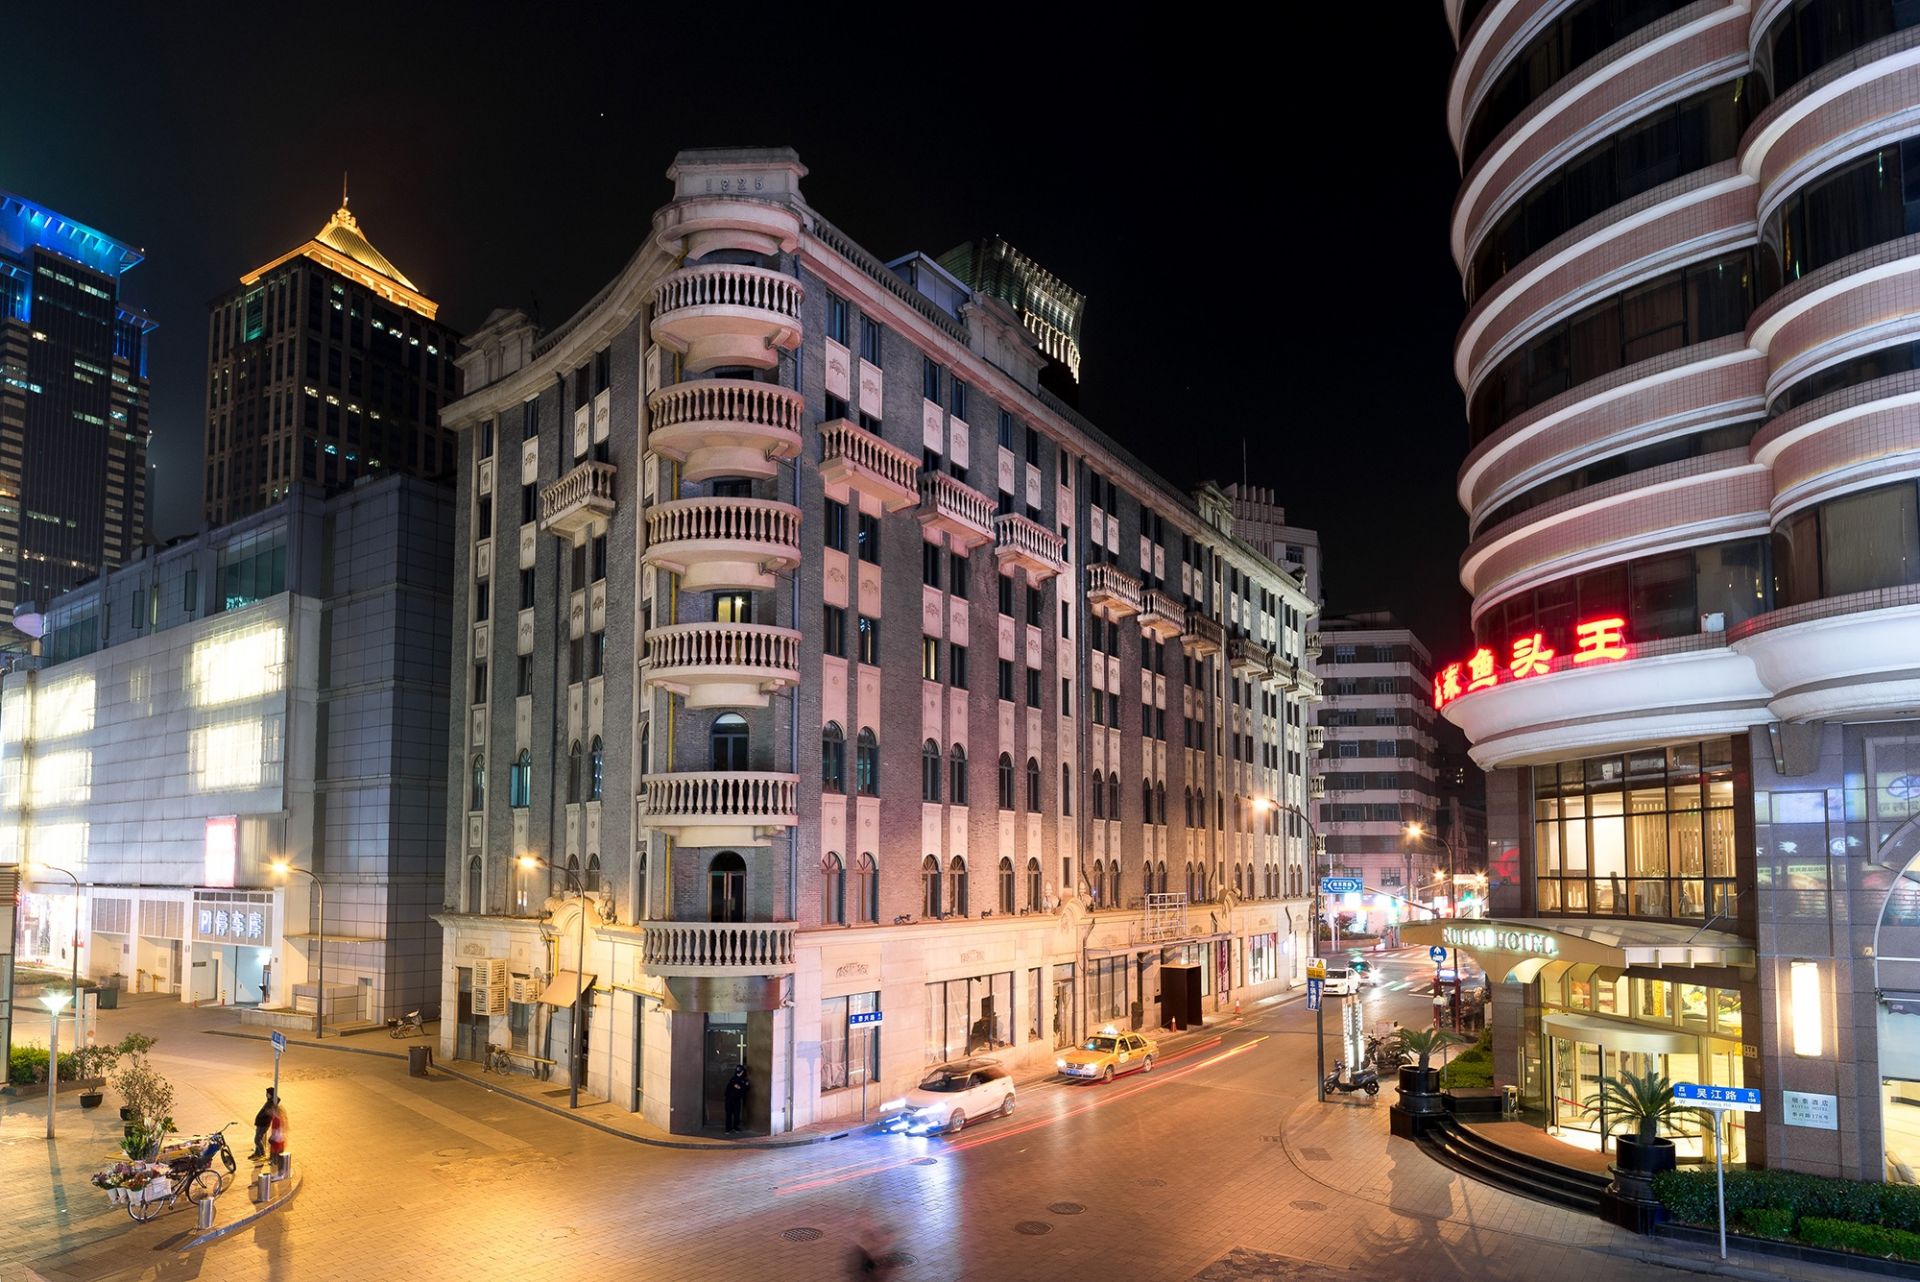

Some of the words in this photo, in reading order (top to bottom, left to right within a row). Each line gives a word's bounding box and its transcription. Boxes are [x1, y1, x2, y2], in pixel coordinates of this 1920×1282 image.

[215, 910, 263, 939] 停车库
[1443, 927, 1489, 947] RUITAI
[1496, 931, 1559, 955] HOTEL
[1696, 1088, 1737, 1101] 吴江路
